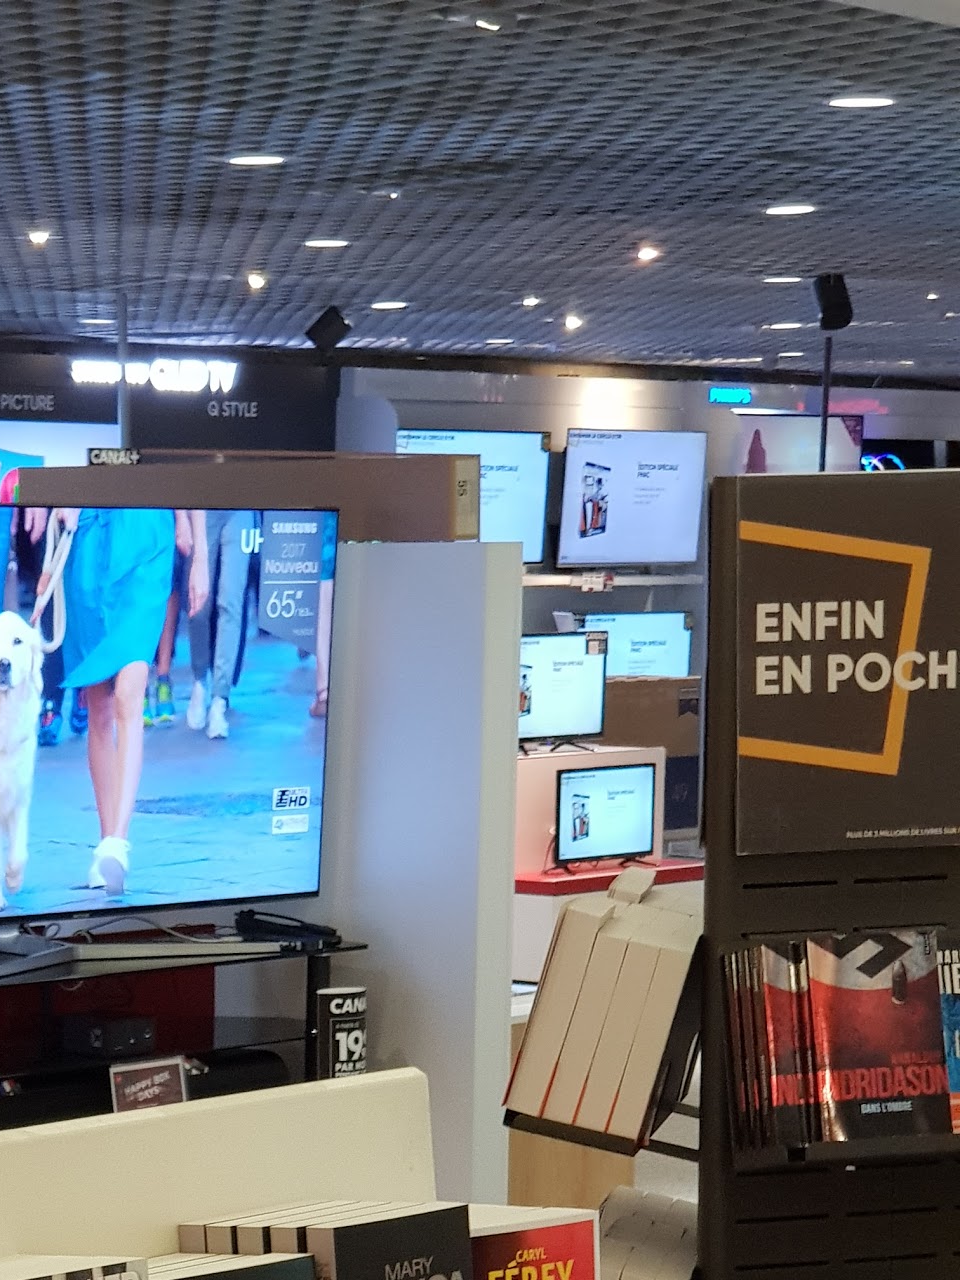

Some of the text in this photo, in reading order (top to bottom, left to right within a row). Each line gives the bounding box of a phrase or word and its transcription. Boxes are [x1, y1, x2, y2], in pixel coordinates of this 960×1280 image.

[1, 393, 55, 412] PICTURE
[207, 400, 259, 418] Q STYLE
[271, 522, 318, 534] SAMSUNG
[281, 543, 305, 559] 2017
[264, 560, 318, 575] Nouveau
[755, 600, 885, 643] ENFIN
[755, 649, 959, 696] EN POCH
[289, 792, 308, 807] HD
[124, 1070, 170, 1097] HAPPY BOX
[818, 1064, 949, 1101] INDRIDASON
[138, 1087, 160, 1102] DAYS
[515, 1247, 546, 1264] CARYL
